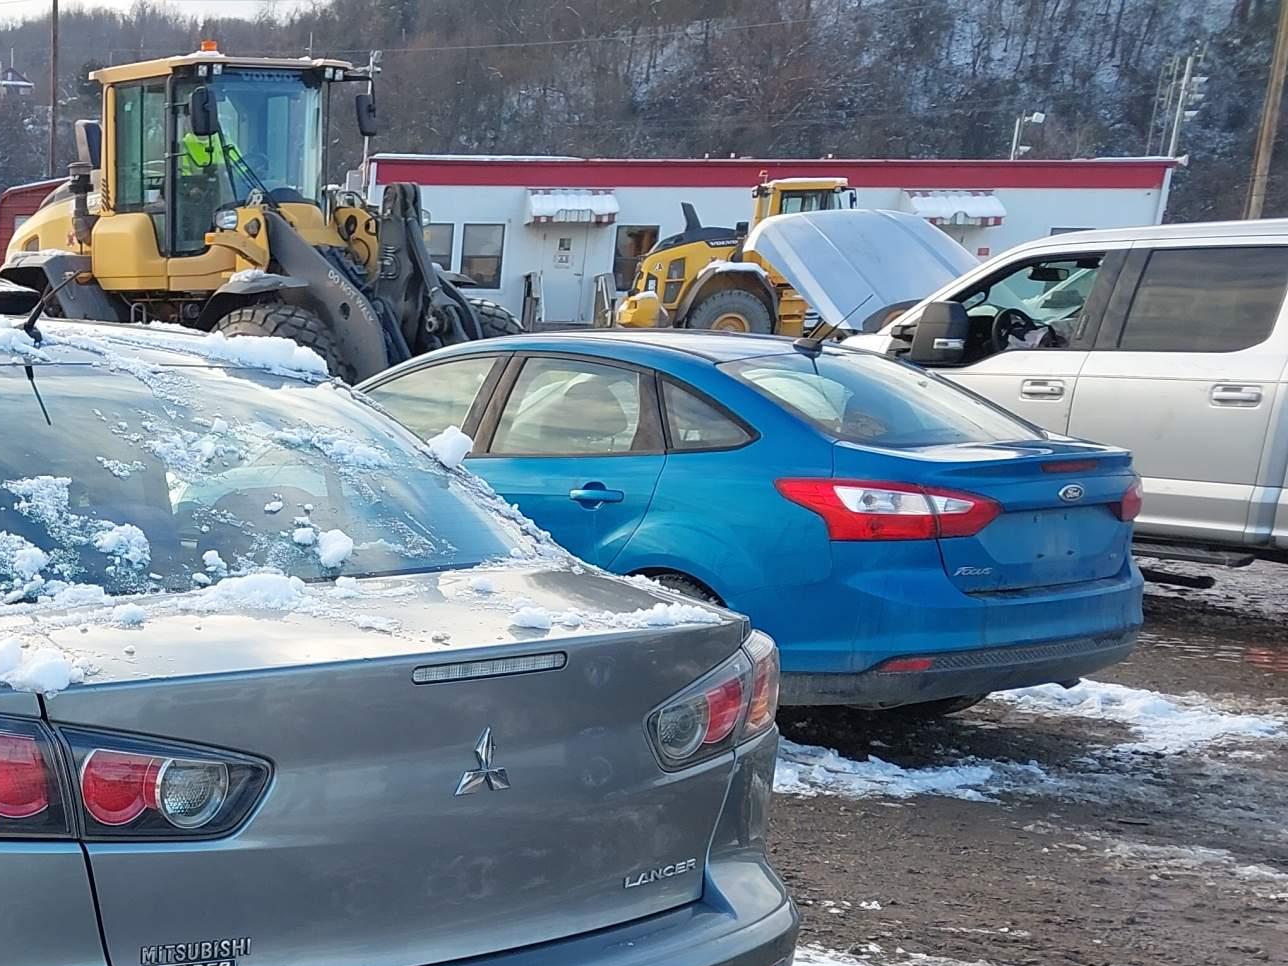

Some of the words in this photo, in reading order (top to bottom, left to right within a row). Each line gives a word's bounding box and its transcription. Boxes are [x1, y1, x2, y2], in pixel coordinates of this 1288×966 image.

[327, 270, 340, 284] DO
[339, 281, 357, 300] NOT
[624, 858, 697, 888] LANCER
[141, 937, 252, 966] MITSUBISHI
